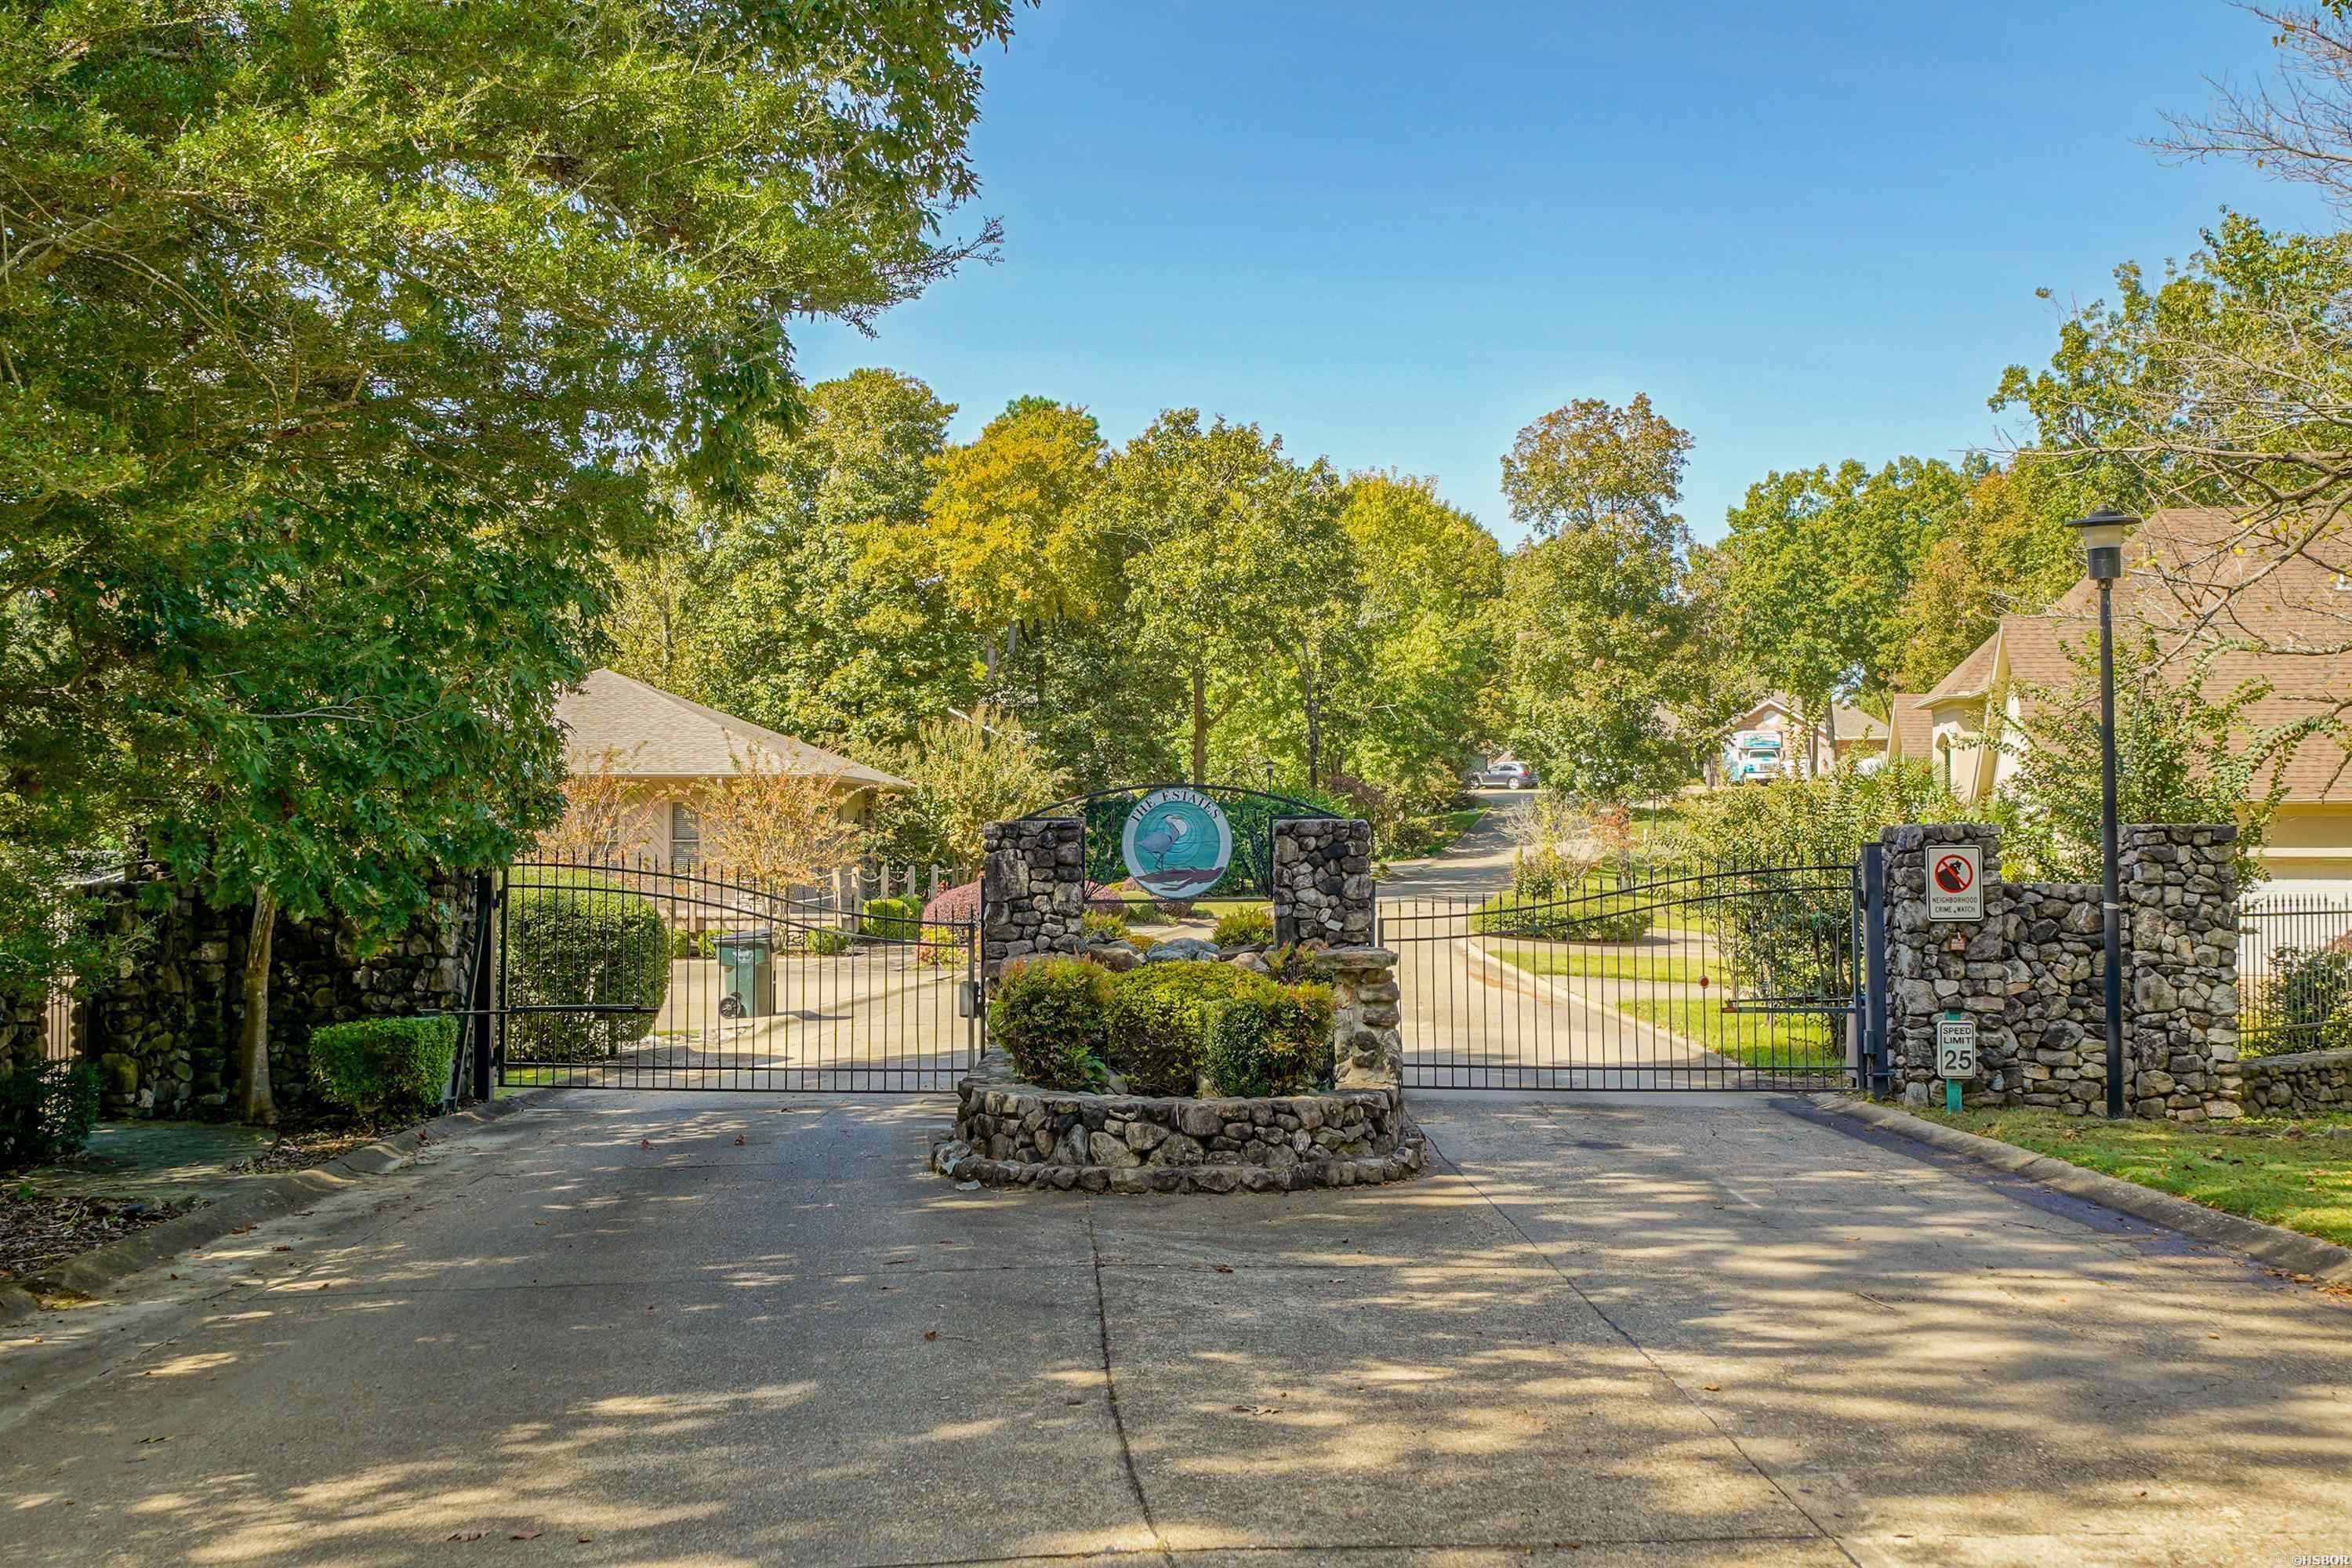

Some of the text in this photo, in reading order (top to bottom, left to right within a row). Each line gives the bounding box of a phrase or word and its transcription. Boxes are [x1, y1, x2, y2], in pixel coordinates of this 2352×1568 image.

[1131, 791, 1222, 822] THE ESTATES
[1944, 1049, 1972, 1070] 25
